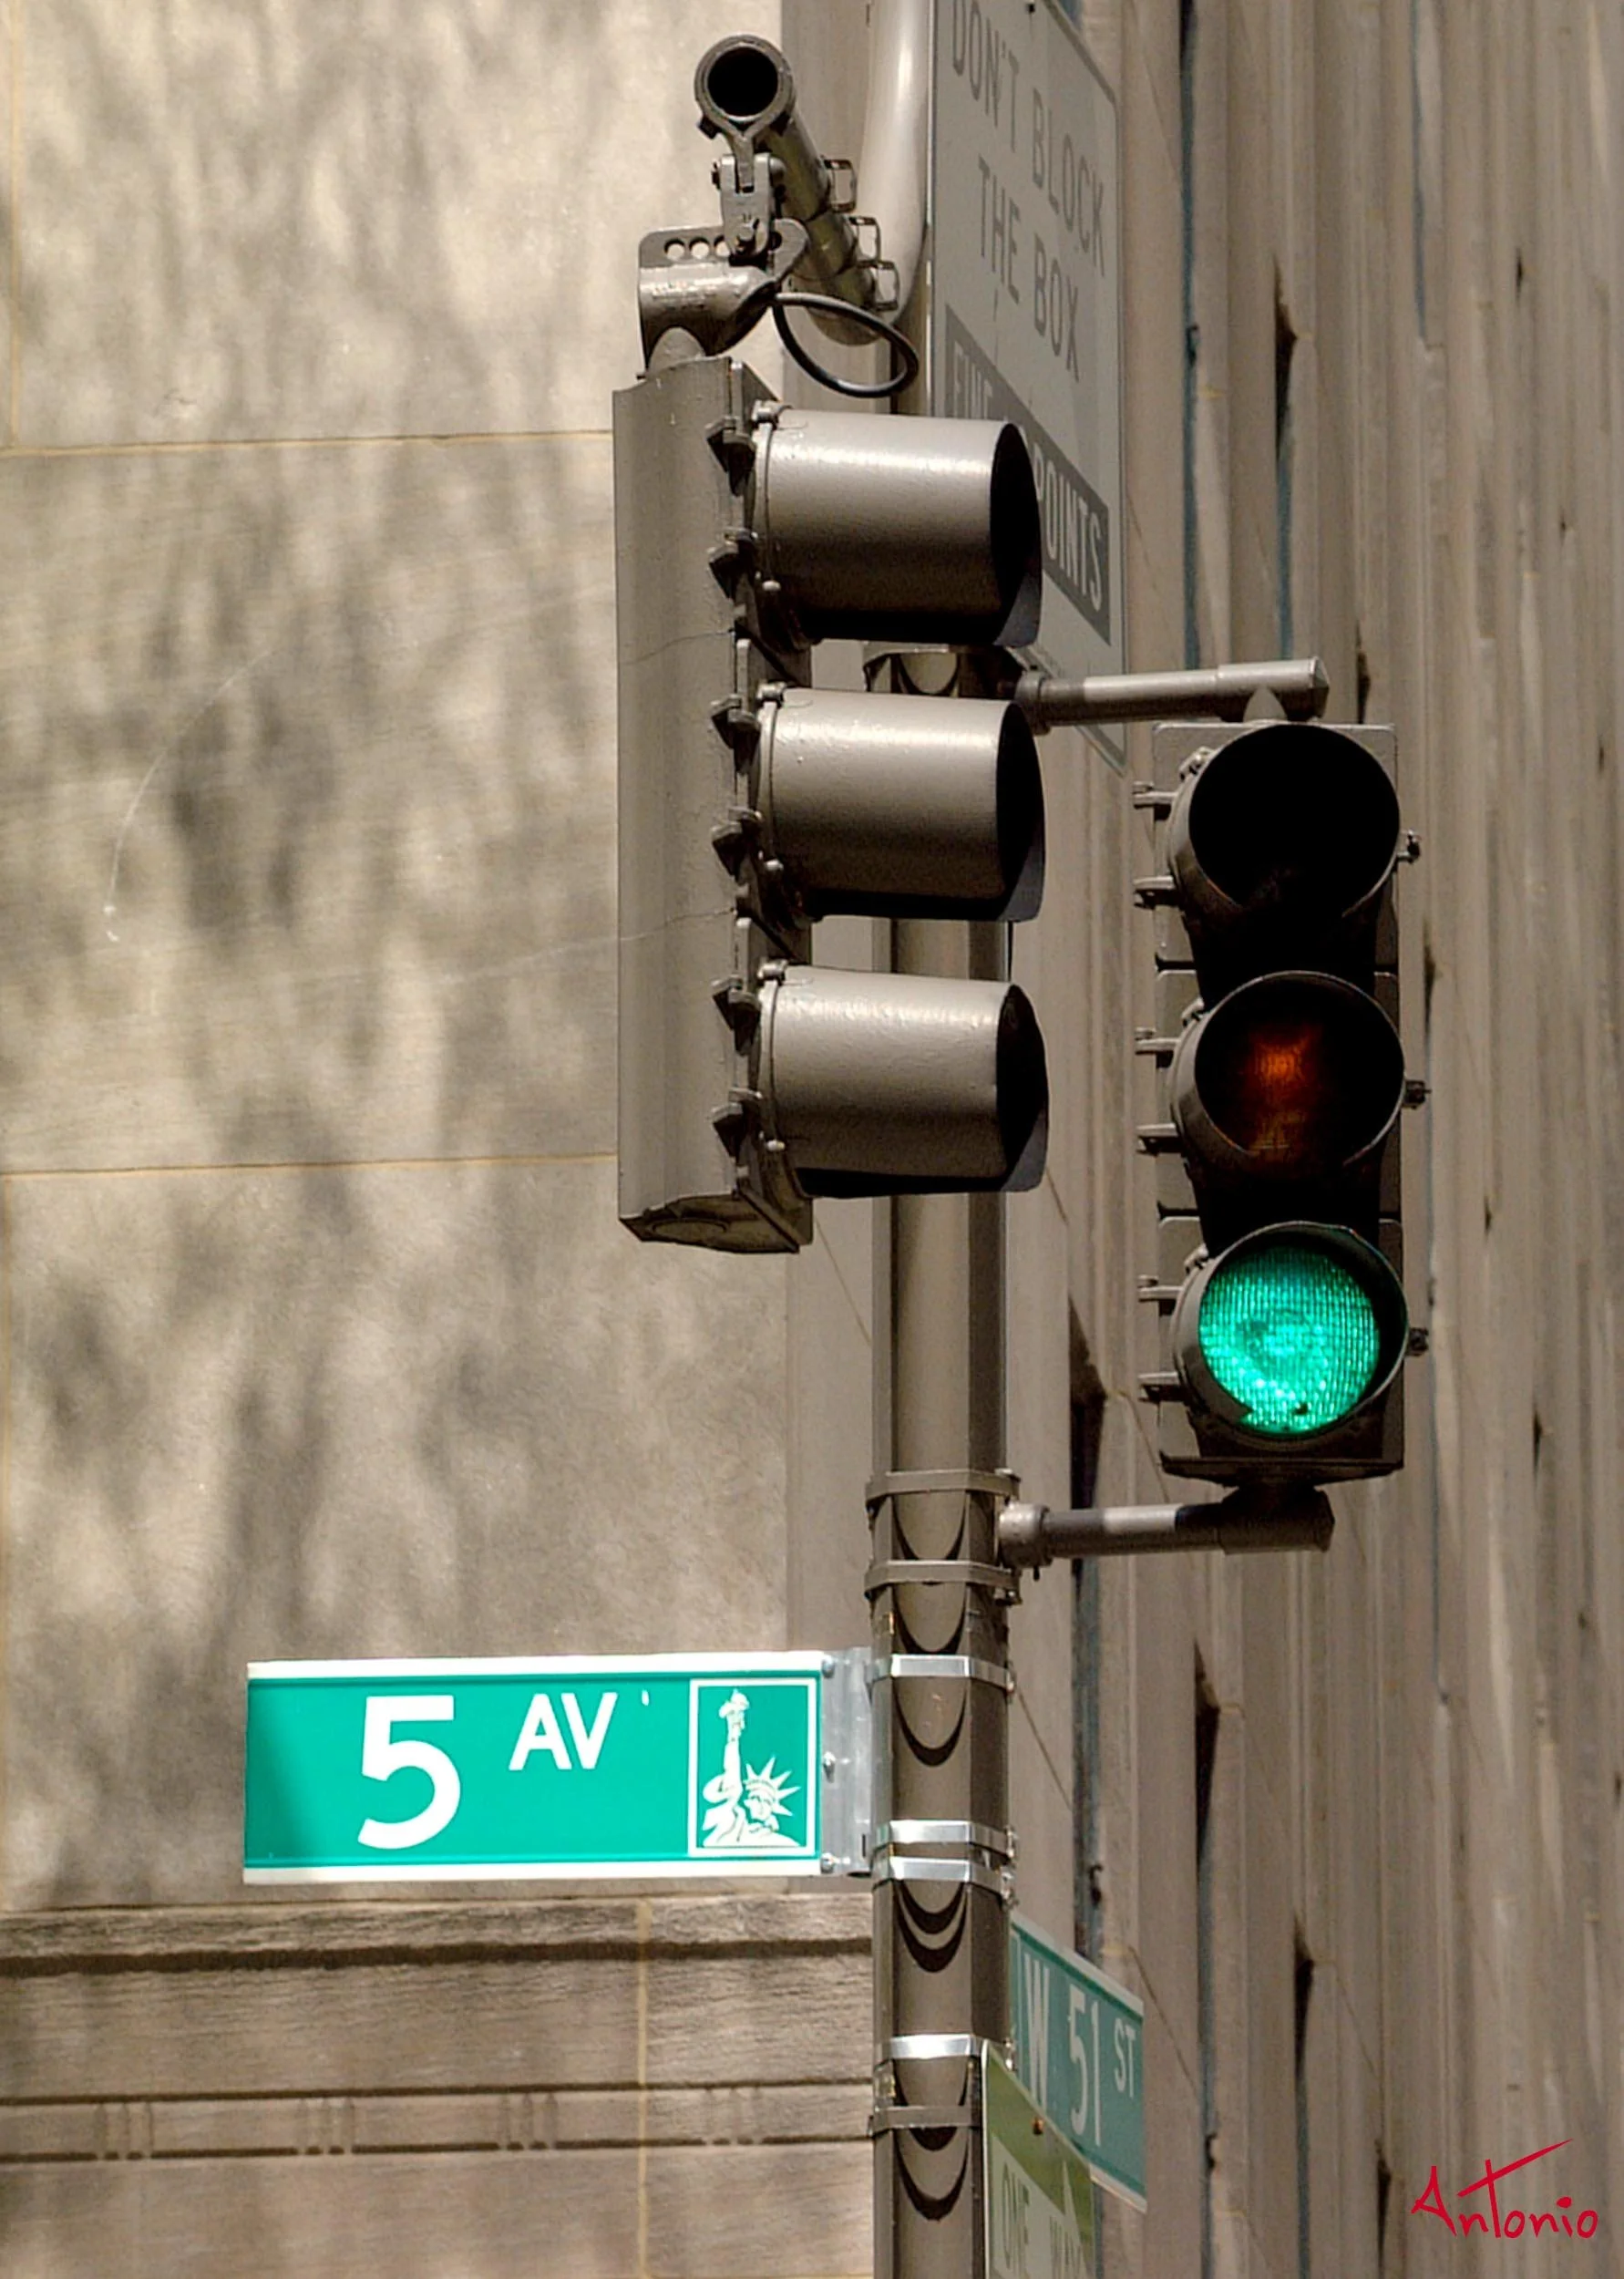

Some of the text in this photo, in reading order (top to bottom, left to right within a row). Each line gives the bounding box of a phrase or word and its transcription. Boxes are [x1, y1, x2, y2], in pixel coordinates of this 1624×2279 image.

[953, 0, 1105, 277] DON'T BLOCK
[979, 153, 1079, 383] THE BOX
[357, 1692, 619, 1850] 5 AV
[1024, 1953, 1137, 2147] W 51 ST
